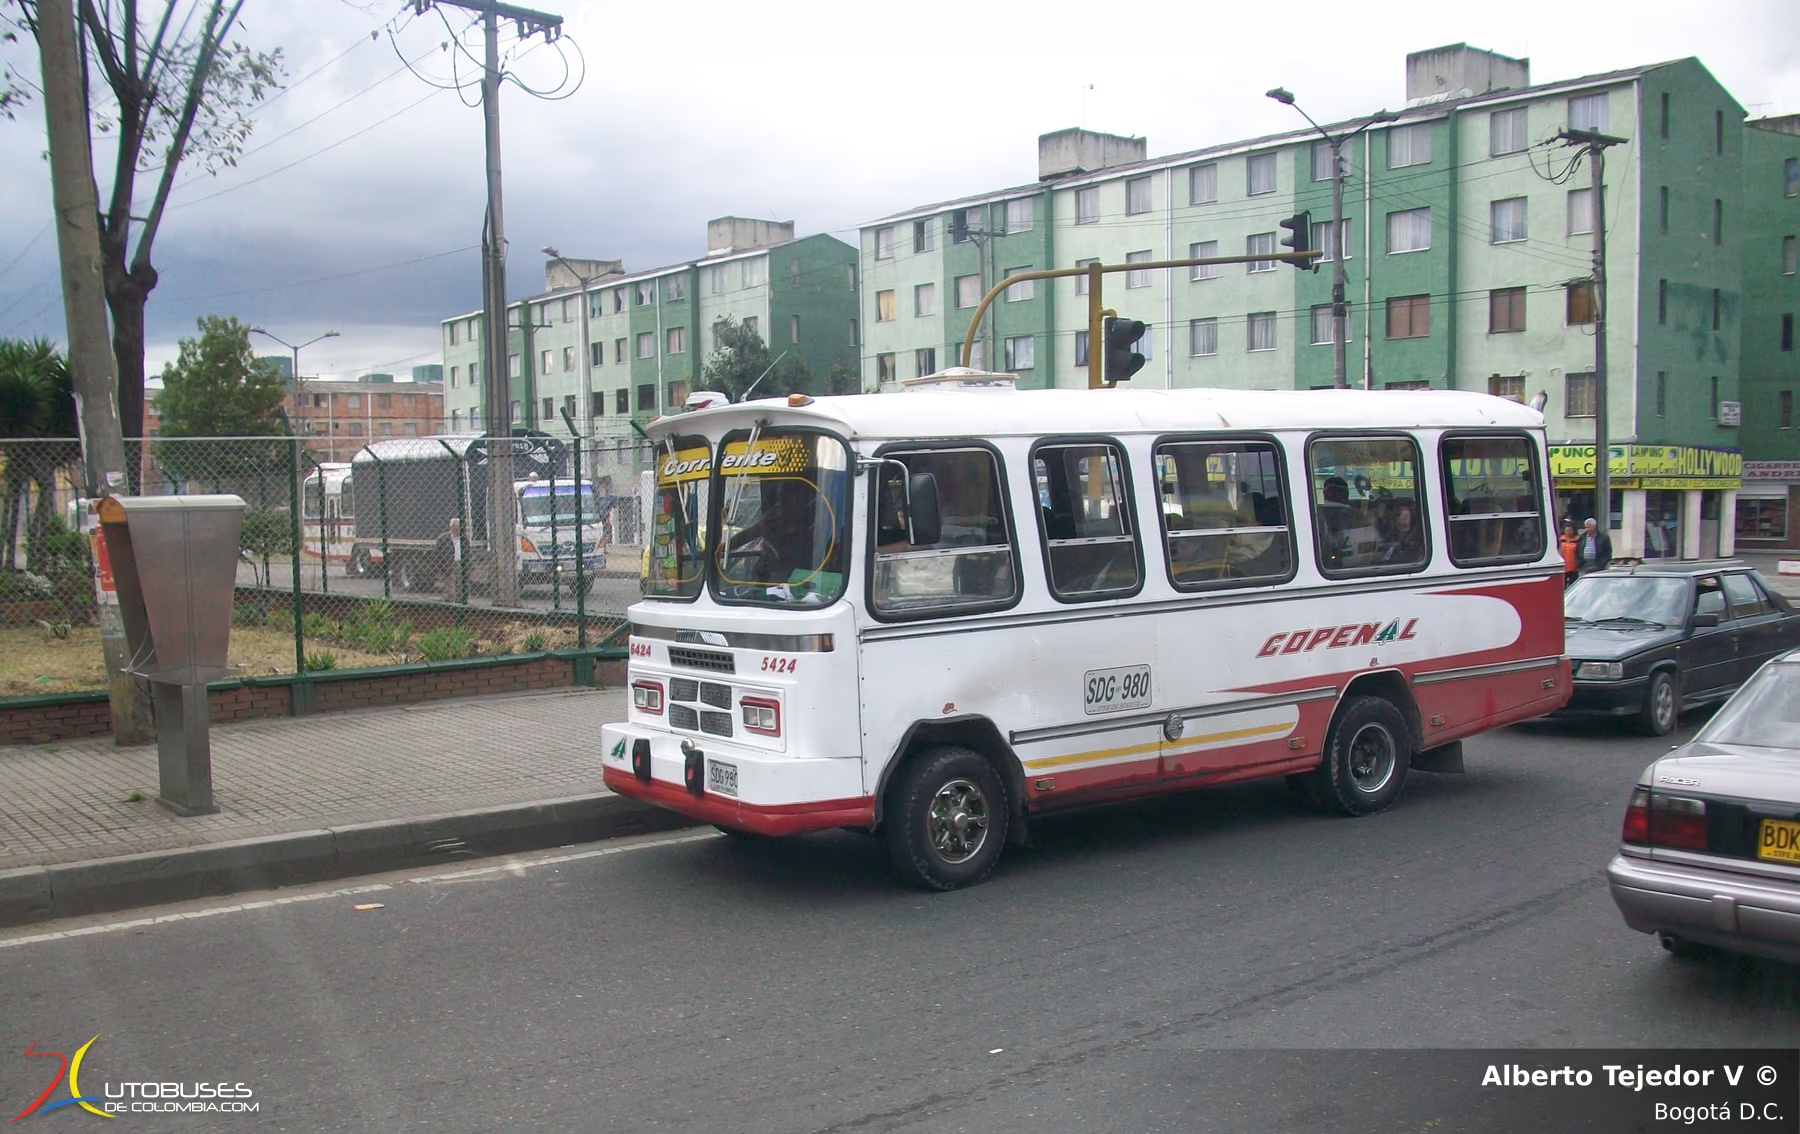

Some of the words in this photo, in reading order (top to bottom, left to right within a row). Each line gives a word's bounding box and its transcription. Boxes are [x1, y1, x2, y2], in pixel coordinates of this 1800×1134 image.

[1678, 446, 1742, 476] HOLLYWOOD
[1255, 616, 1419, 658] COPENAL
[630, 643, 652, 658] 5424
[761, 657, 798, 674] 5424
[1086, 675, 1116, 704] SDG
[1121, 671, 1149, 700] 980
[710, 764, 724, 785] SDG
[1660, 775, 1700, 787] RACER
